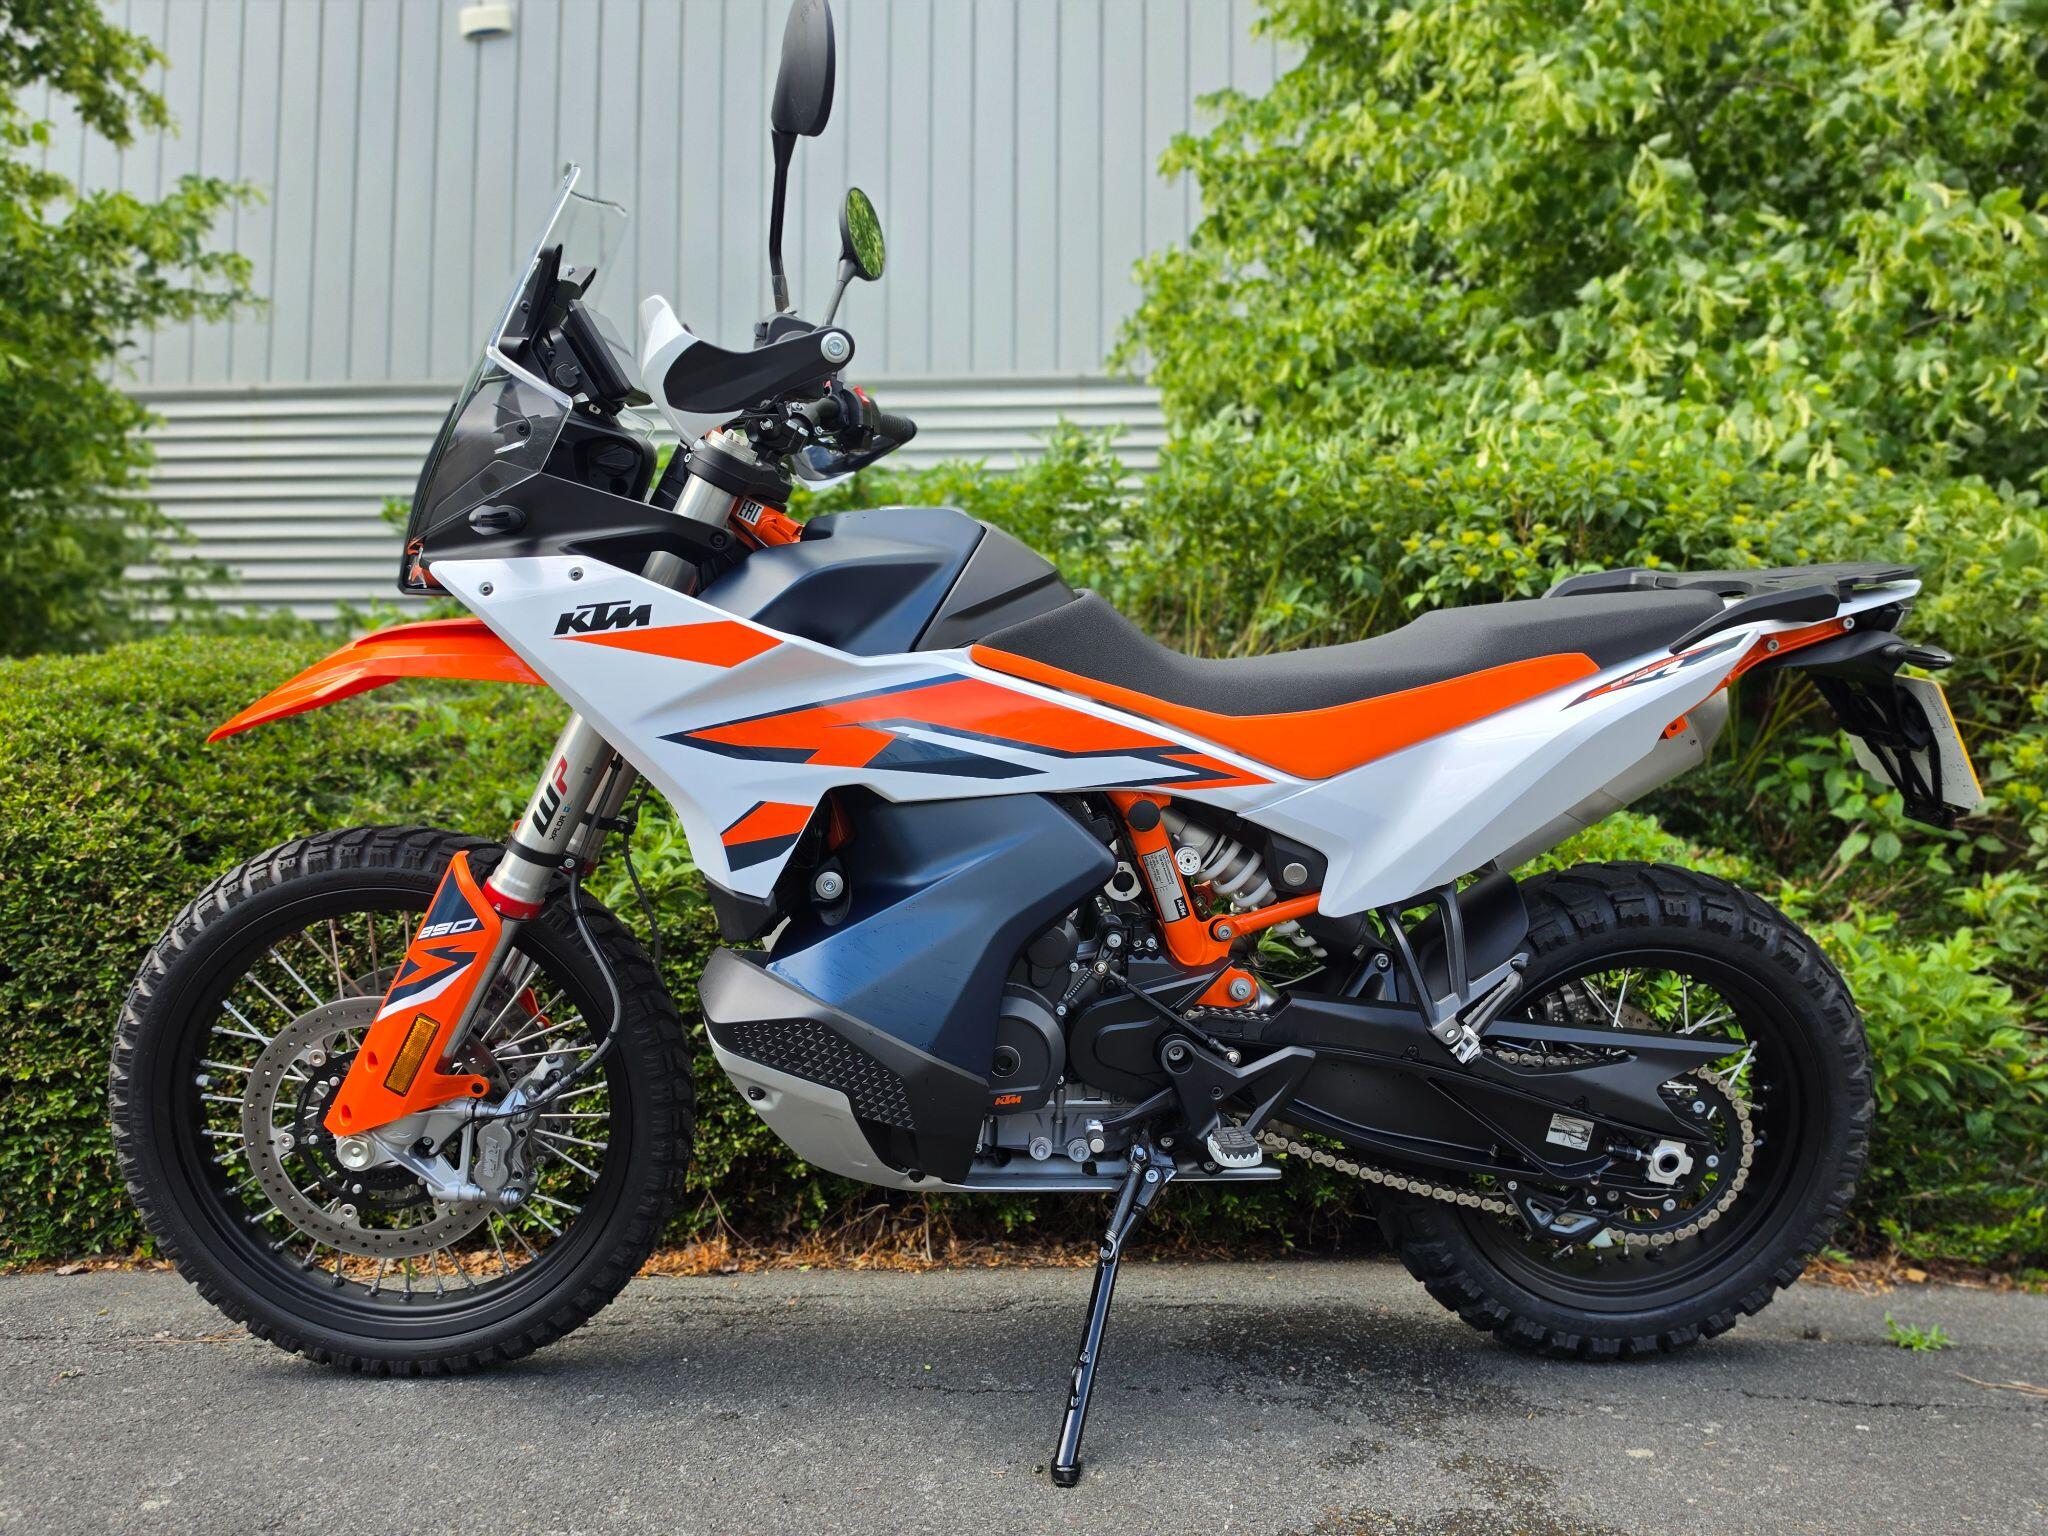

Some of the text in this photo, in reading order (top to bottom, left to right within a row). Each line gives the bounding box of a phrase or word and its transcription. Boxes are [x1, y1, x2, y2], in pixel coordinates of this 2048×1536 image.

[739, 499, 762, 523] EAC
[553, 600, 652, 635] KTM
[532, 754, 568, 838] WP
[549, 814, 567, 841] XPLOR
[1176, 899, 1187, 916] KTM
[417, 917, 478, 940] 890
[994, 1094, 1022, 1106] KTM
